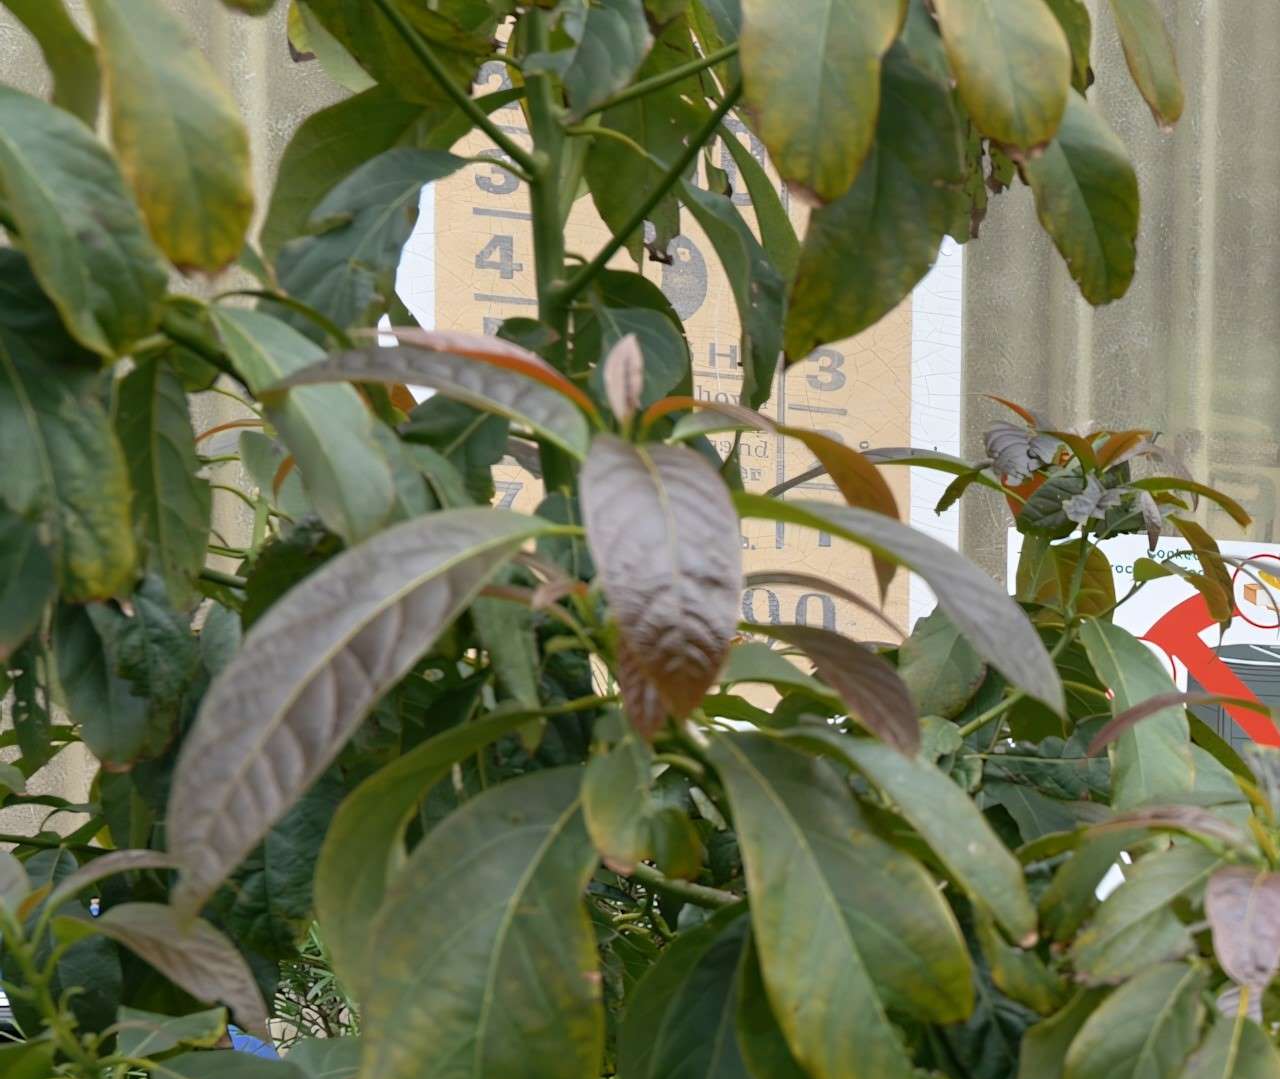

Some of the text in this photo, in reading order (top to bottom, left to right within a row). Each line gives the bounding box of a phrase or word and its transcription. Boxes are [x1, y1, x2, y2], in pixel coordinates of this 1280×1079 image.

[475, 149, 520, 195] 3
[475, 235, 523, 280] 4
[806, 350, 847, 392] 3
